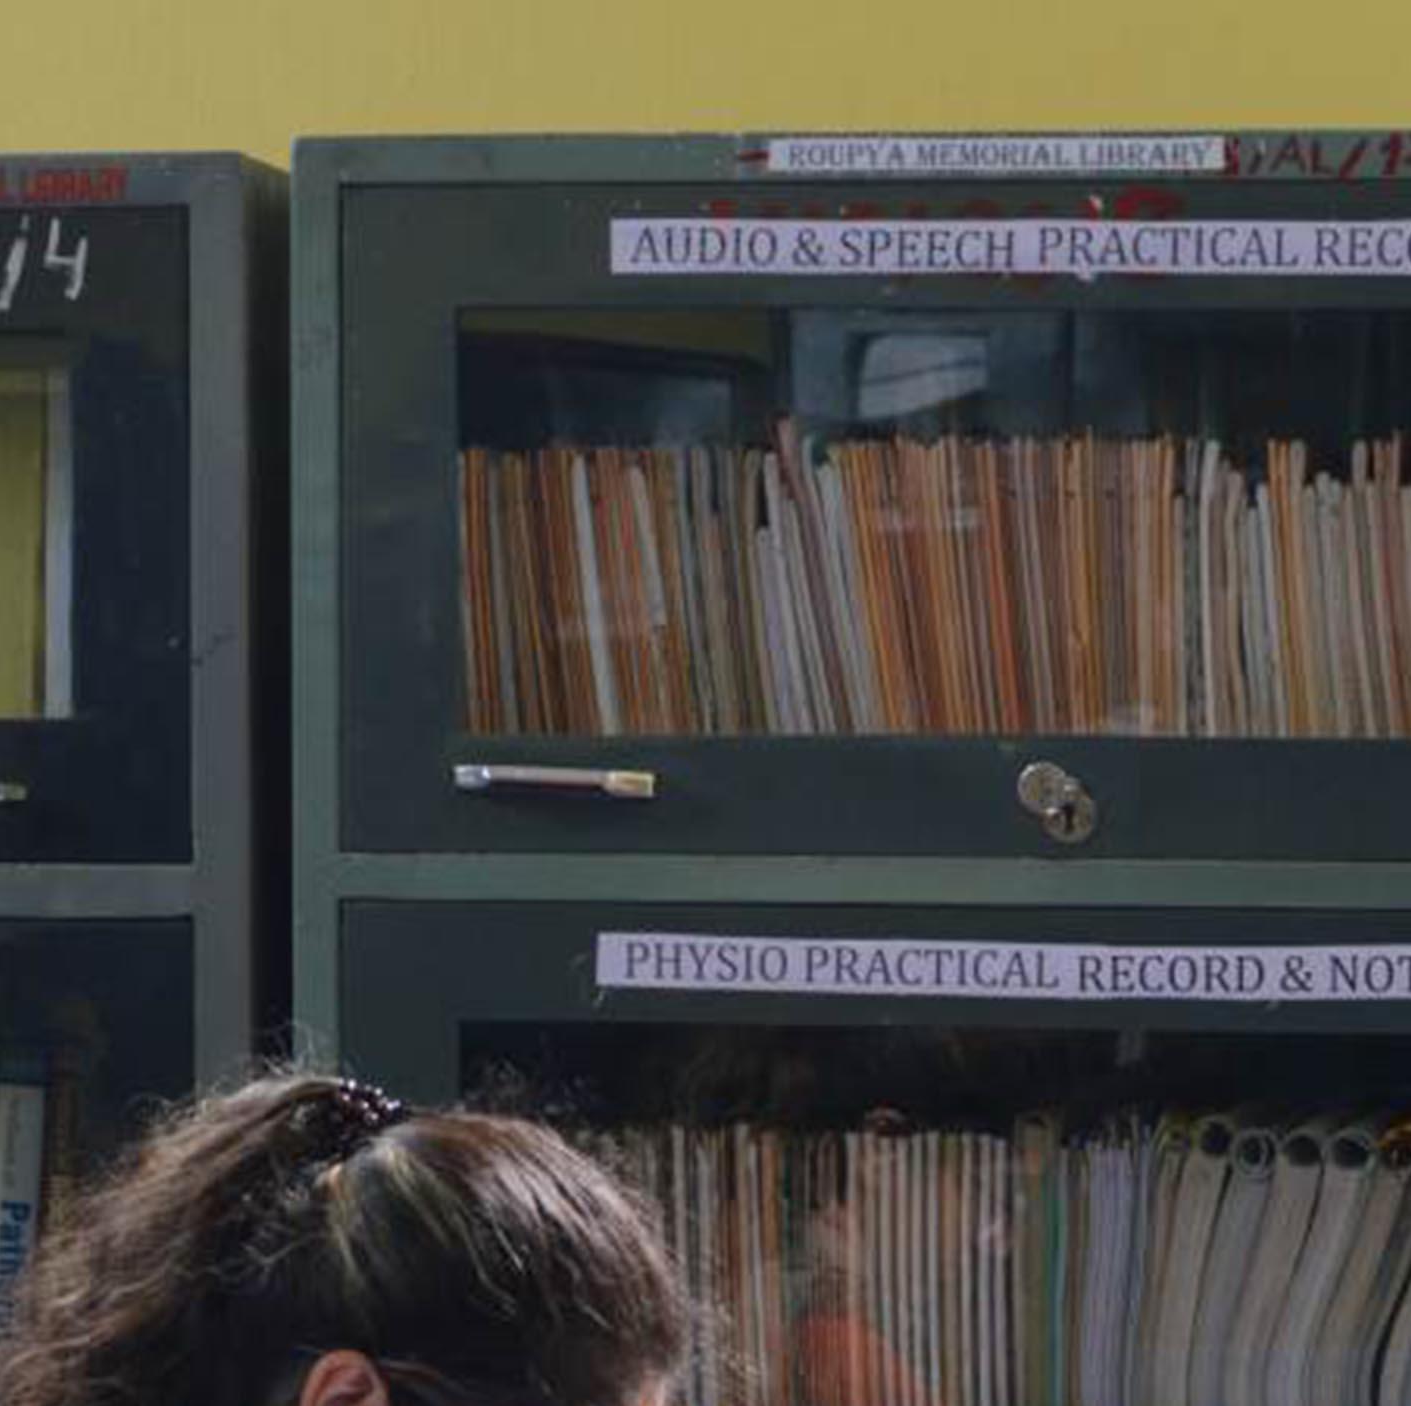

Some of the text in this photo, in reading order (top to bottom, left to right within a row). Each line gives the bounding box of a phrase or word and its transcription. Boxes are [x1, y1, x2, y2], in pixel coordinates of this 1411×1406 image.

[789, 142, 1213, 167] ROUPYA MEMORIAL LIBRARY
[631, 226, 778, 265] AUDIO
[792, 228, 826, 265] &
[839, 228, 1015, 268] SPEECH
[1038, 226, 1298, 268] PRACTICAL
[625, 940, 788, 984] PHYSIO
[804, 945, 1061, 989] PRACTICAL
[1078, 952, 1265, 994] RECORD
[1279, 954, 1314, 993] &
